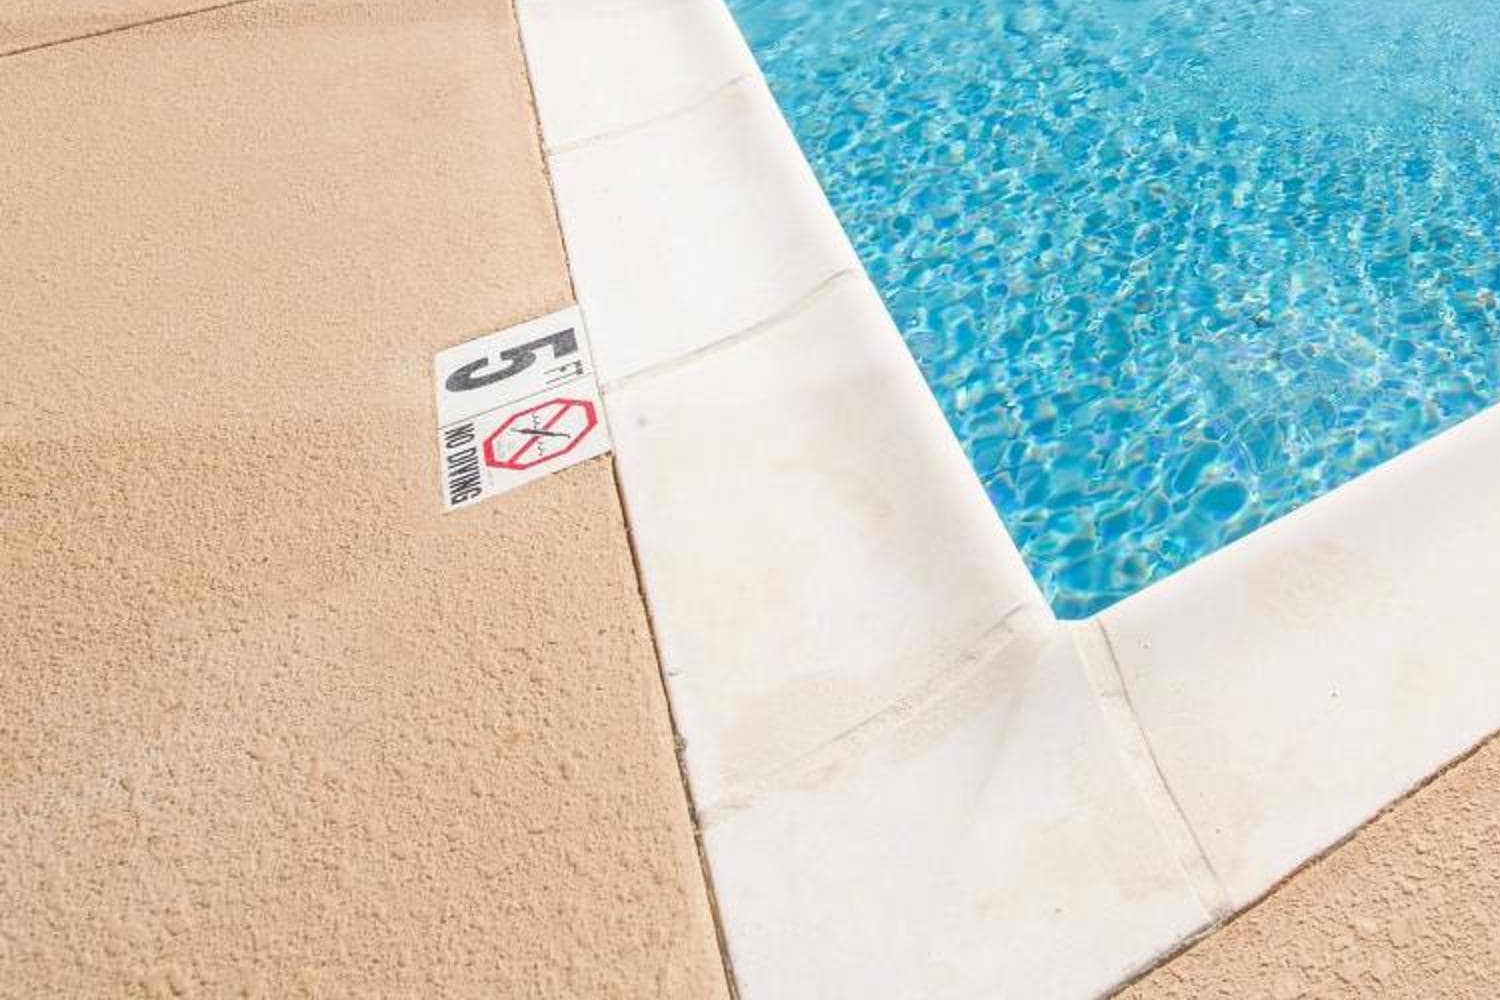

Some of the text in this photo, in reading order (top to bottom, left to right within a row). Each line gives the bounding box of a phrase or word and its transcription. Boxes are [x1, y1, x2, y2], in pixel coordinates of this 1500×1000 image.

[445, 327, 579, 393] 5
[444, 422, 483, 506] NO DIVING
